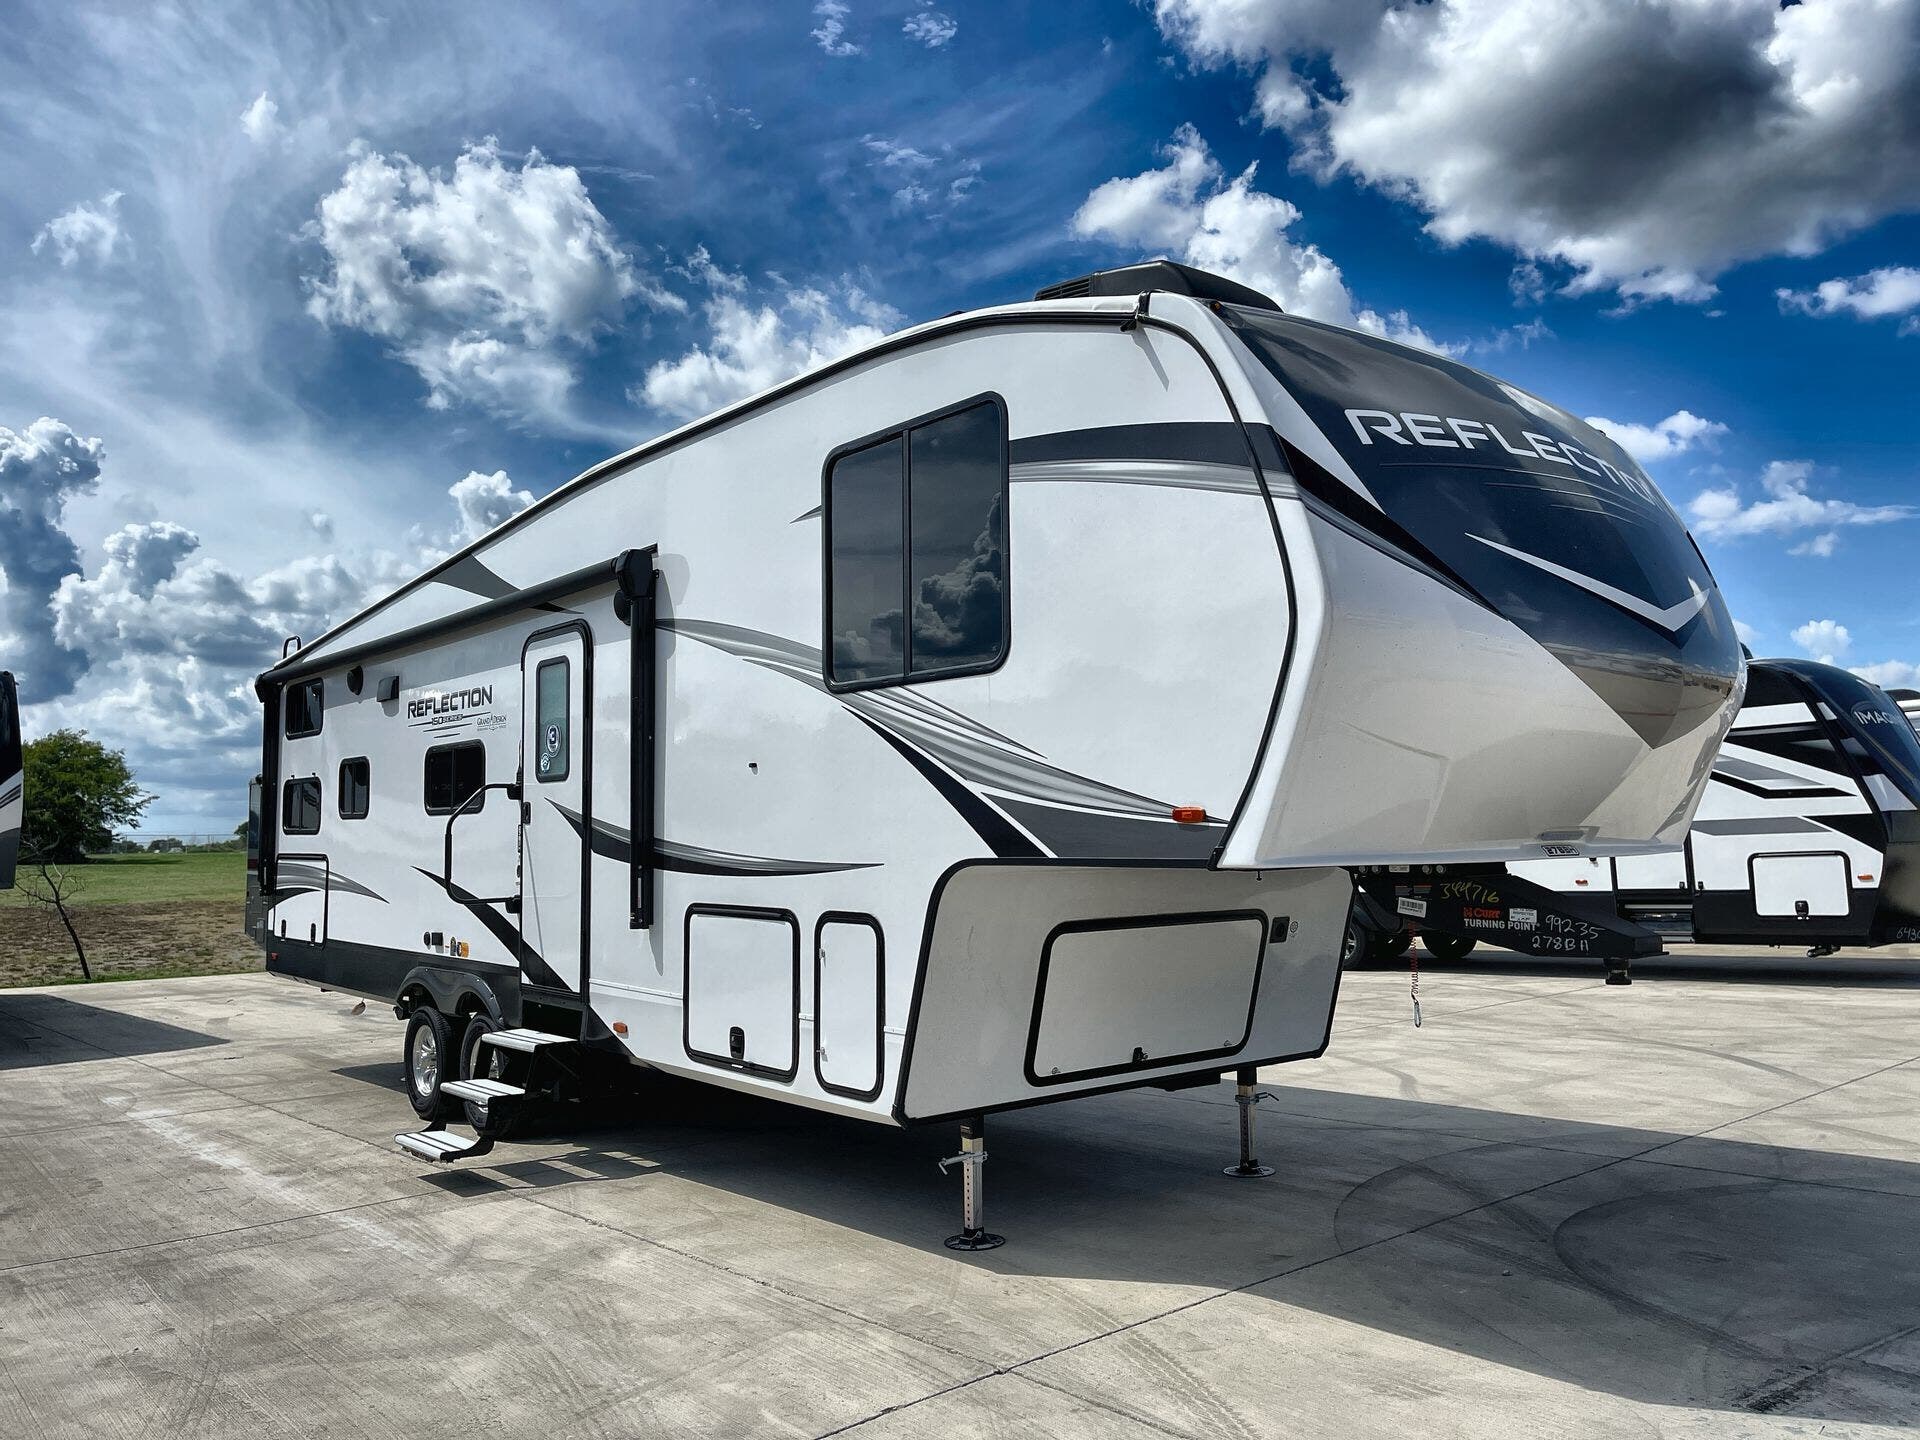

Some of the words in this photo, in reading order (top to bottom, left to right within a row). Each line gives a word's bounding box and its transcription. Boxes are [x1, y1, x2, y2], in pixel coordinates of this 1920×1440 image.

[408, 685, 493, 719] REFLECTION
[1464, 918, 1505, 930] TURNING
[1507, 920, 1536, 931] POINT
[1546, 914, 1606, 940] 99235
